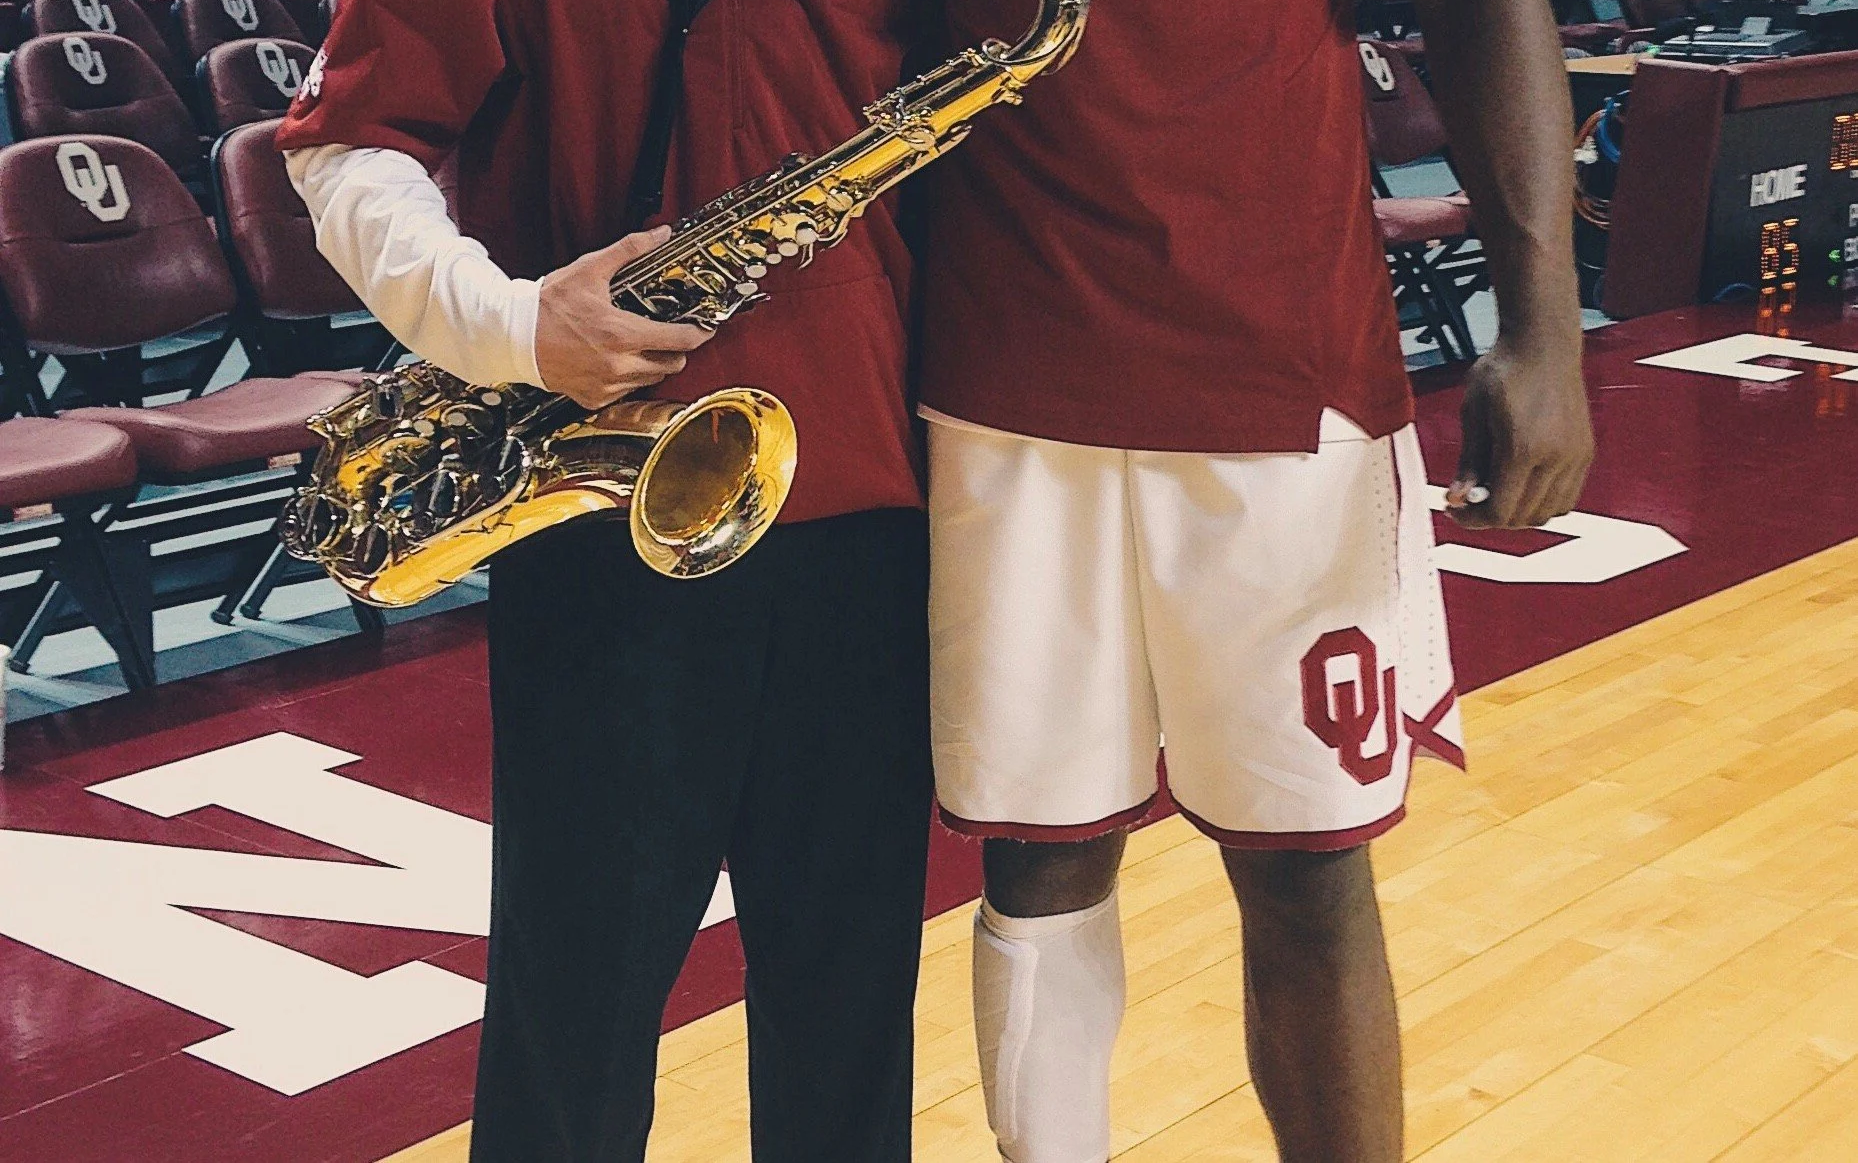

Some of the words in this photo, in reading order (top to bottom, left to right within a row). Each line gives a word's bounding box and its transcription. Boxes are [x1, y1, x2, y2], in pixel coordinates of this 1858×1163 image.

[63, 37, 108, 85] OU
[255, 40, 301, 97] OU
[55, 142, 130, 222] OU
[1750, 164, 1807, 207] HOME
[1300, 626, 1397, 786] OU
